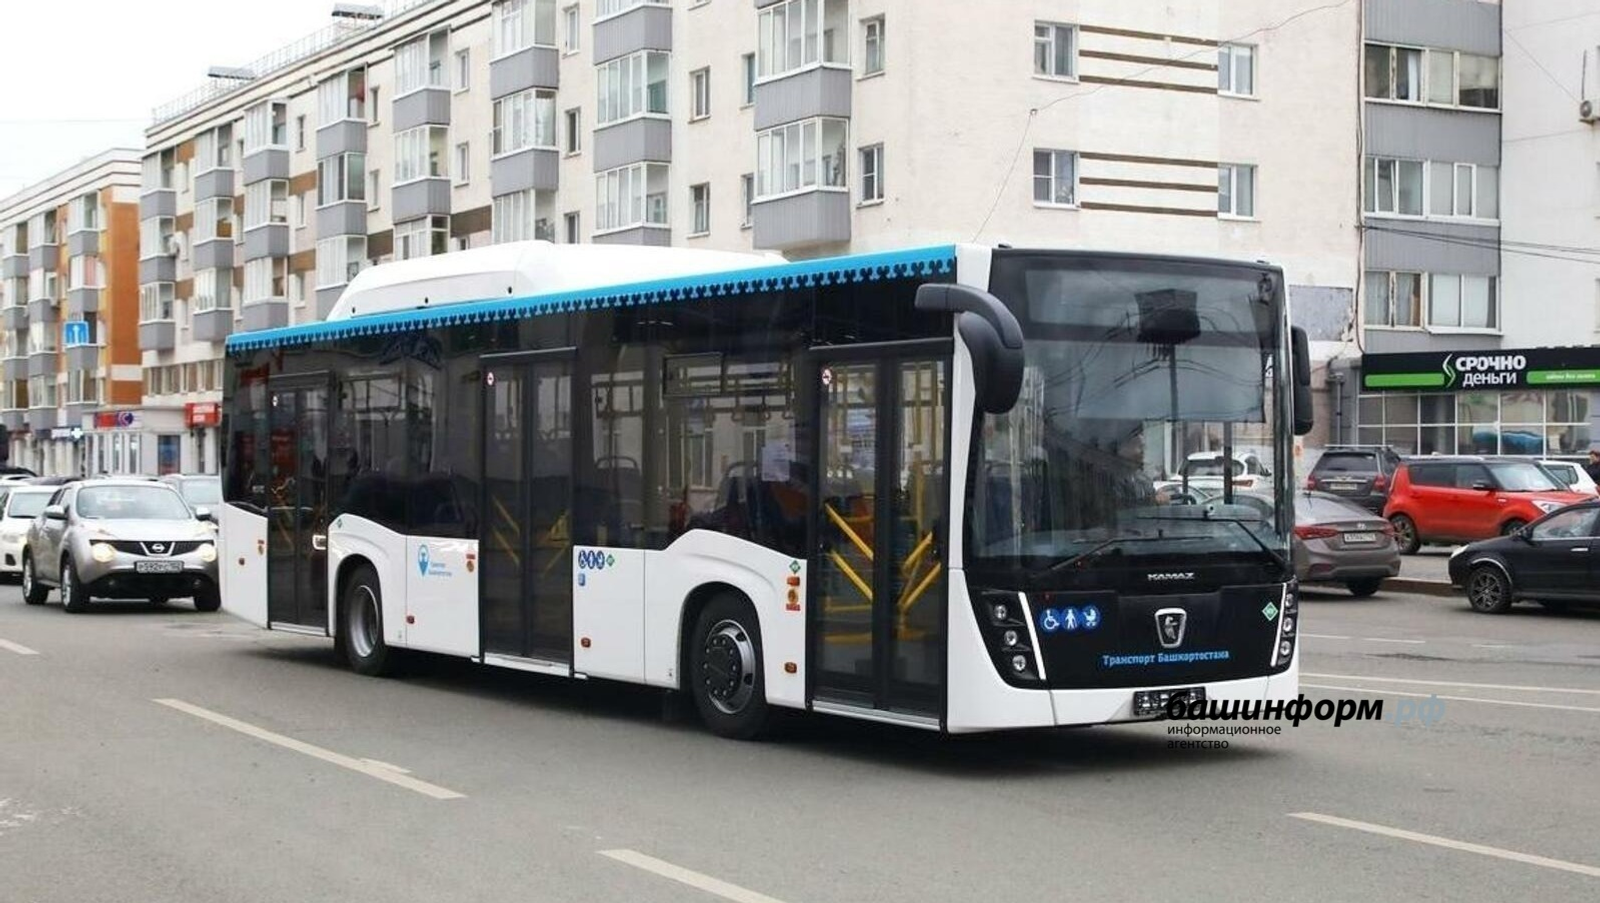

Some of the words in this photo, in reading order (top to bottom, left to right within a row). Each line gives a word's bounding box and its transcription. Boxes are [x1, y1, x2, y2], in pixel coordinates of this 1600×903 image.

[1455, 355, 1526, 371] СРОЧНО
[1462, 372, 1517, 387] деньги
[1147, 572, 1195, 580] KAMAZ
[1103, 655, 1156, 667] Транспорт
[1157, 651, 1230, 663] Башкортостана
